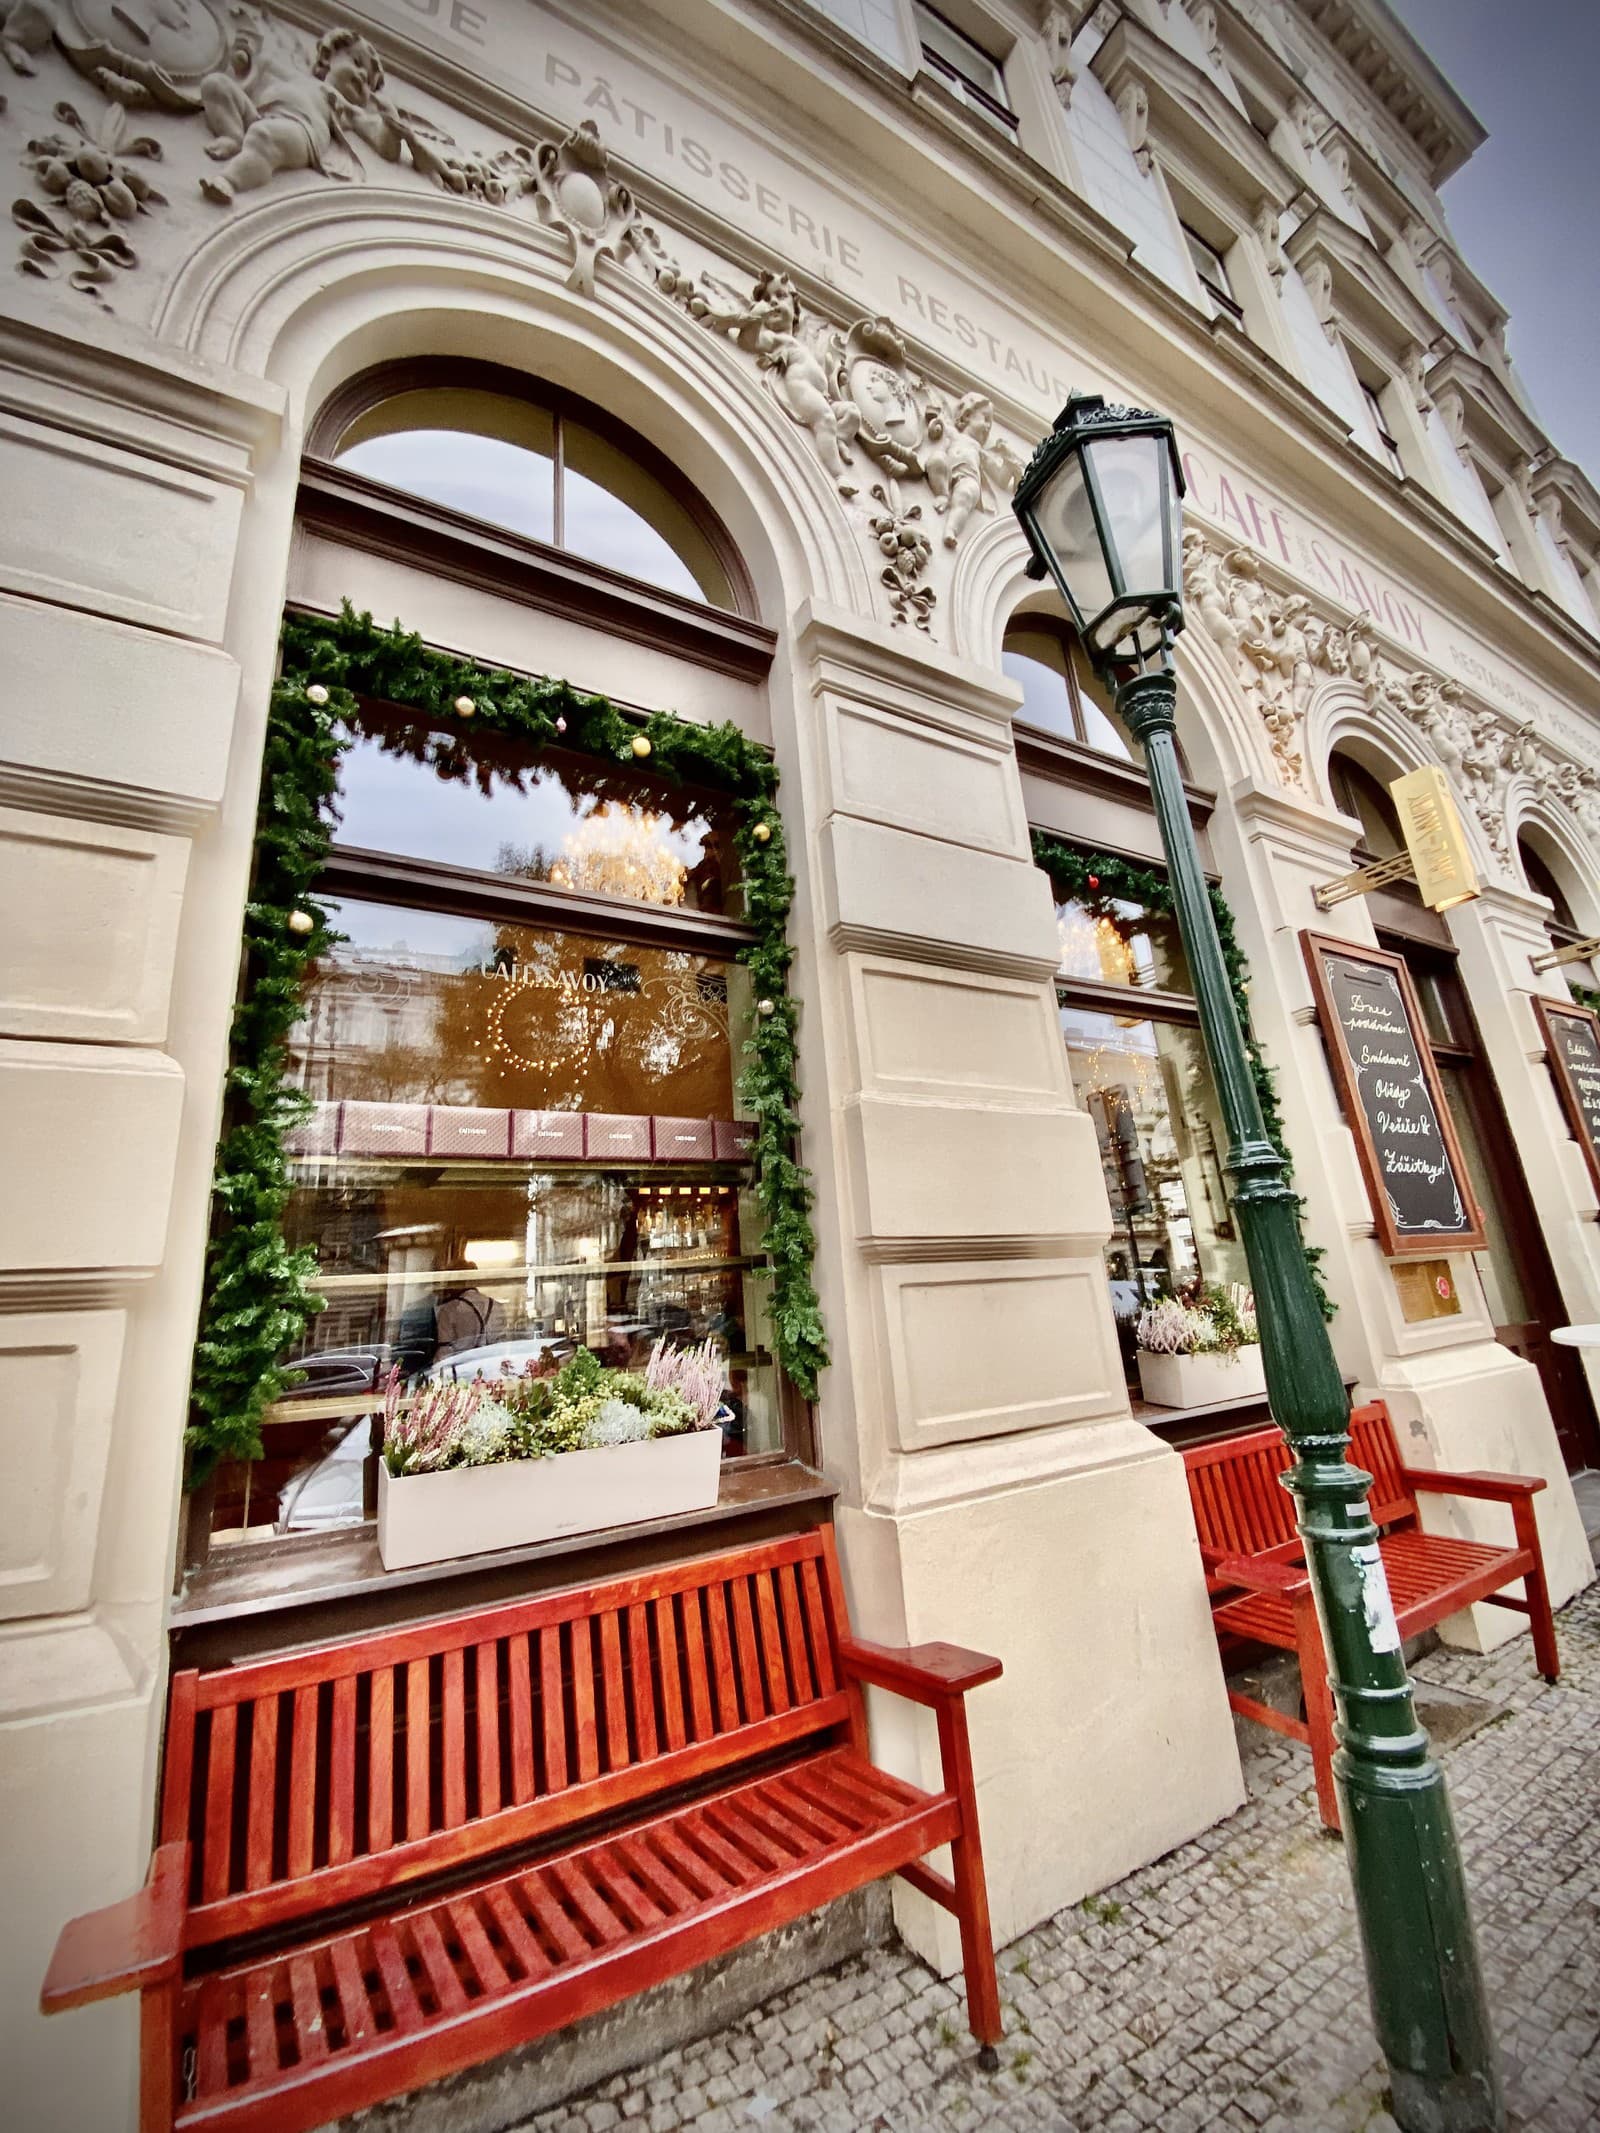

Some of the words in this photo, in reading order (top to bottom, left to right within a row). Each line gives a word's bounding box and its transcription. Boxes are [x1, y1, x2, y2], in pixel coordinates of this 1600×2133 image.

[545, 53, 863, 278] PÂTISSERIE
[1183, 452, 1291, 564] CAFÉ
[1311, 540, 1429, 652] SAVOY
[1350, 994, 1392, 1016] Dnes
